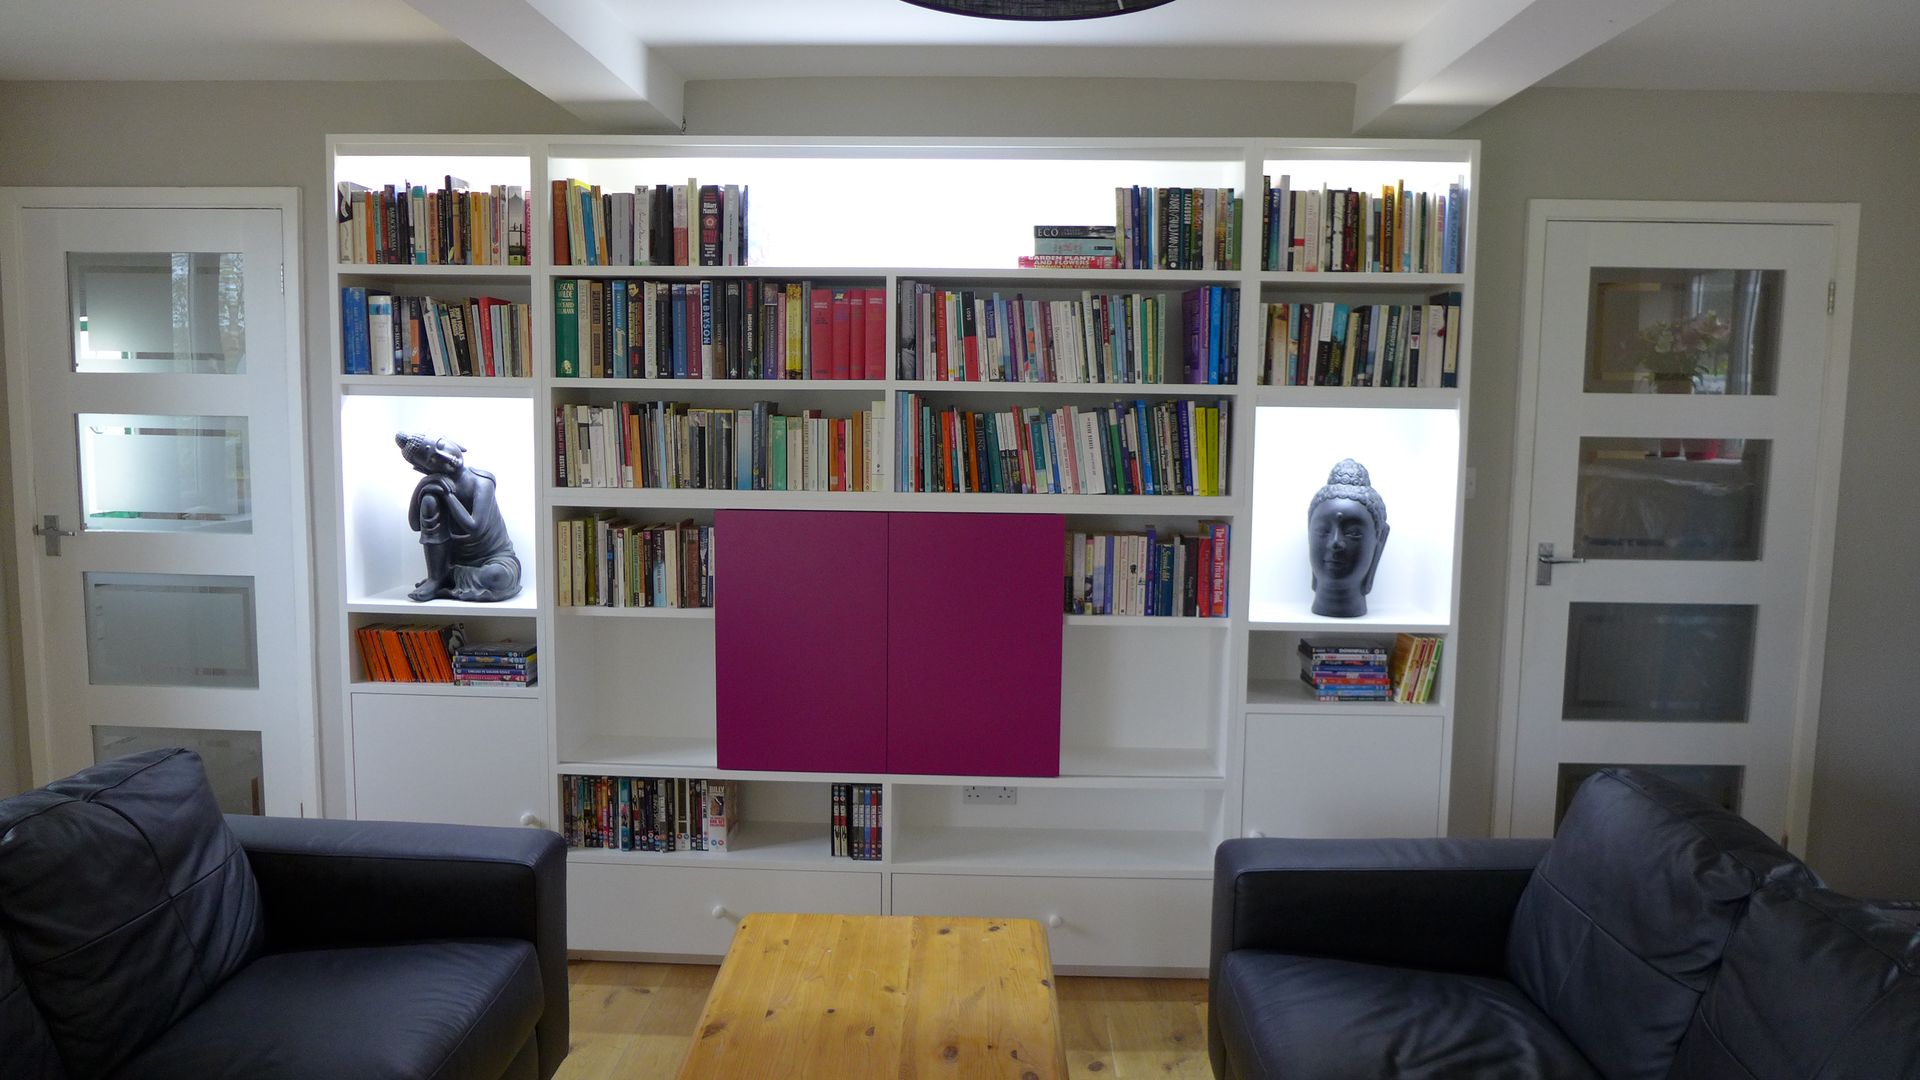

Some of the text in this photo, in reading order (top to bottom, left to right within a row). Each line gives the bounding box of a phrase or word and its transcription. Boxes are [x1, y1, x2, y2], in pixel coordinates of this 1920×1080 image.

[457, 321, 465, 340] FOWLES
[1390, 316, 1398, 346] INGENIOUS
[1216, 528, 1225, 538] The
[1215, 562, 1224, 578] Trivia
[1214, 579, 1222, 590] Quiz
